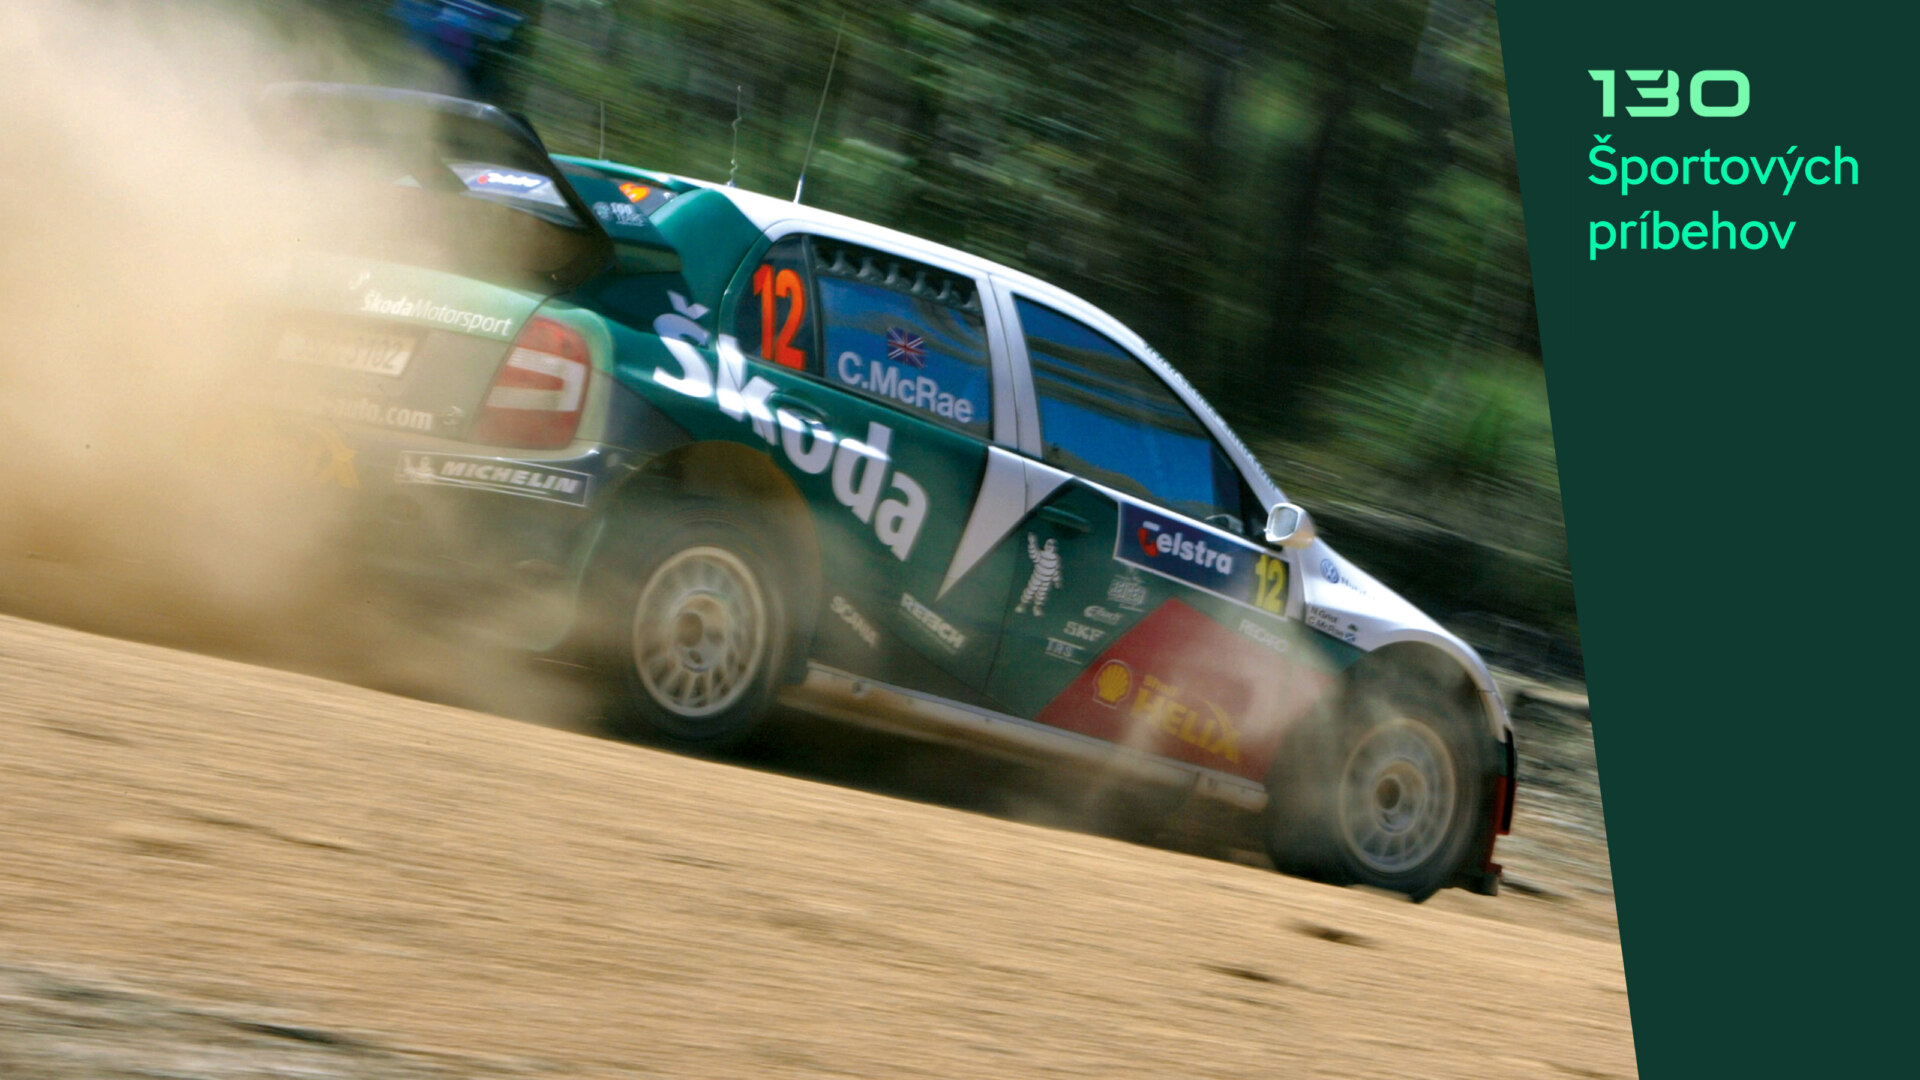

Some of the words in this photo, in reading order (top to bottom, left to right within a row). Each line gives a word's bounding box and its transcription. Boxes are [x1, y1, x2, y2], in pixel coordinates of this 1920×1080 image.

[753, 264, 806, 372] 12
[838, 351, 974, 424] C.McRae
[653, 290, 929, 561] Škoda
[440, 461, 582, 495] MICHELIN
[1138, 520, 1232, 574] Telstra
[1254, 554, 1286, 615] 12
[1064, 621, 1106, 642] SKF
